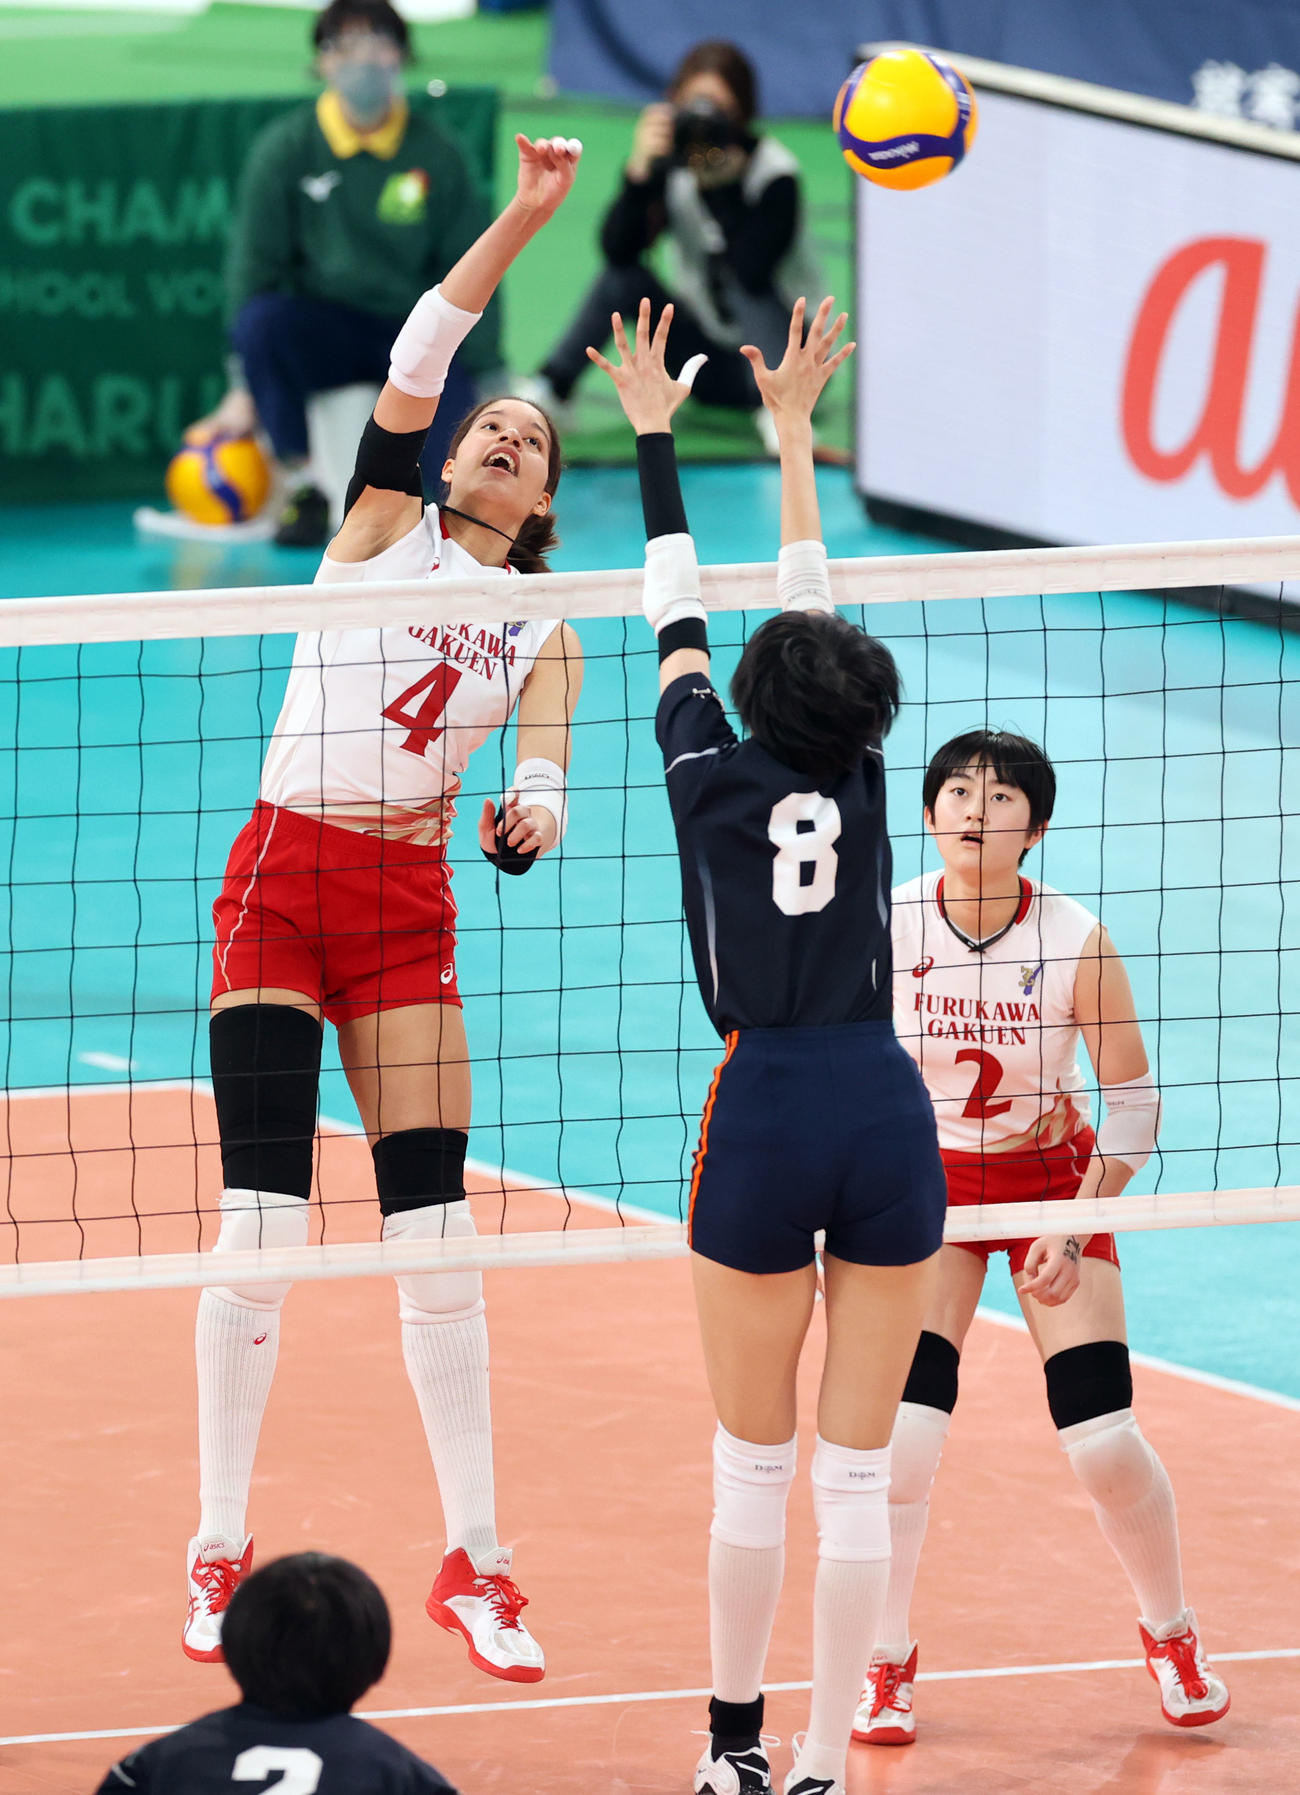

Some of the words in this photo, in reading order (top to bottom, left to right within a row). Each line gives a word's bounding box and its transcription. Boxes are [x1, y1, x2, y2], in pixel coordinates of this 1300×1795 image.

[408, 624, 498, 680] GAKUEN
[380, 661, 462, 757] 4
[768, 790, 841, 916] 8
[913, 992, 1040, 1022] FURUKAWA
[928, 1018, 1026, 1046] GAKUEN
[954, 1048, 1013, 1119] 2
